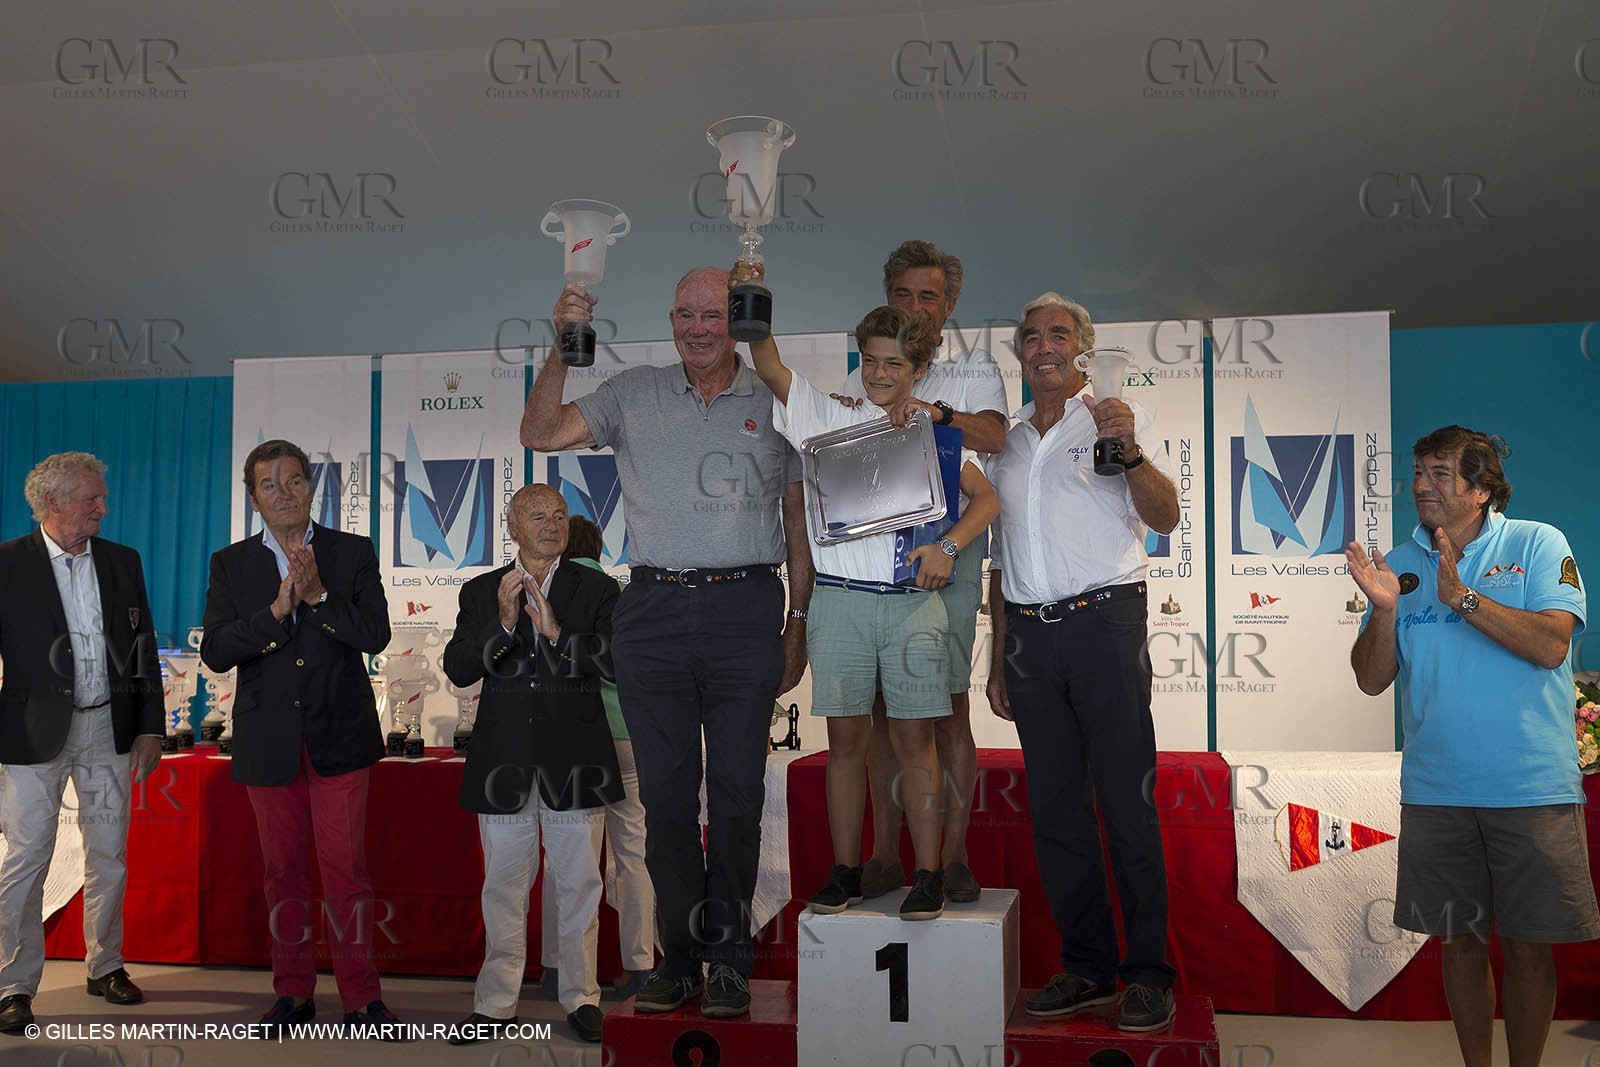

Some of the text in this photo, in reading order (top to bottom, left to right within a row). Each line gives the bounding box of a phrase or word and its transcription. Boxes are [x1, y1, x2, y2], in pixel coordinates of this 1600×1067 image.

[420, 396, 484, 411] ROLEX
[1363, 433, 1380, 563] aint-Tropez
[500, 457, 514, 566] aint-Tropez
[1150, 566, 1173, 578] de
[1232, 564, 1267, 576] Les
[1272, 563, 1329, 576] Voiles
[392, 576, 421, 586] Les
[875, 943, 909, 1022] 1
